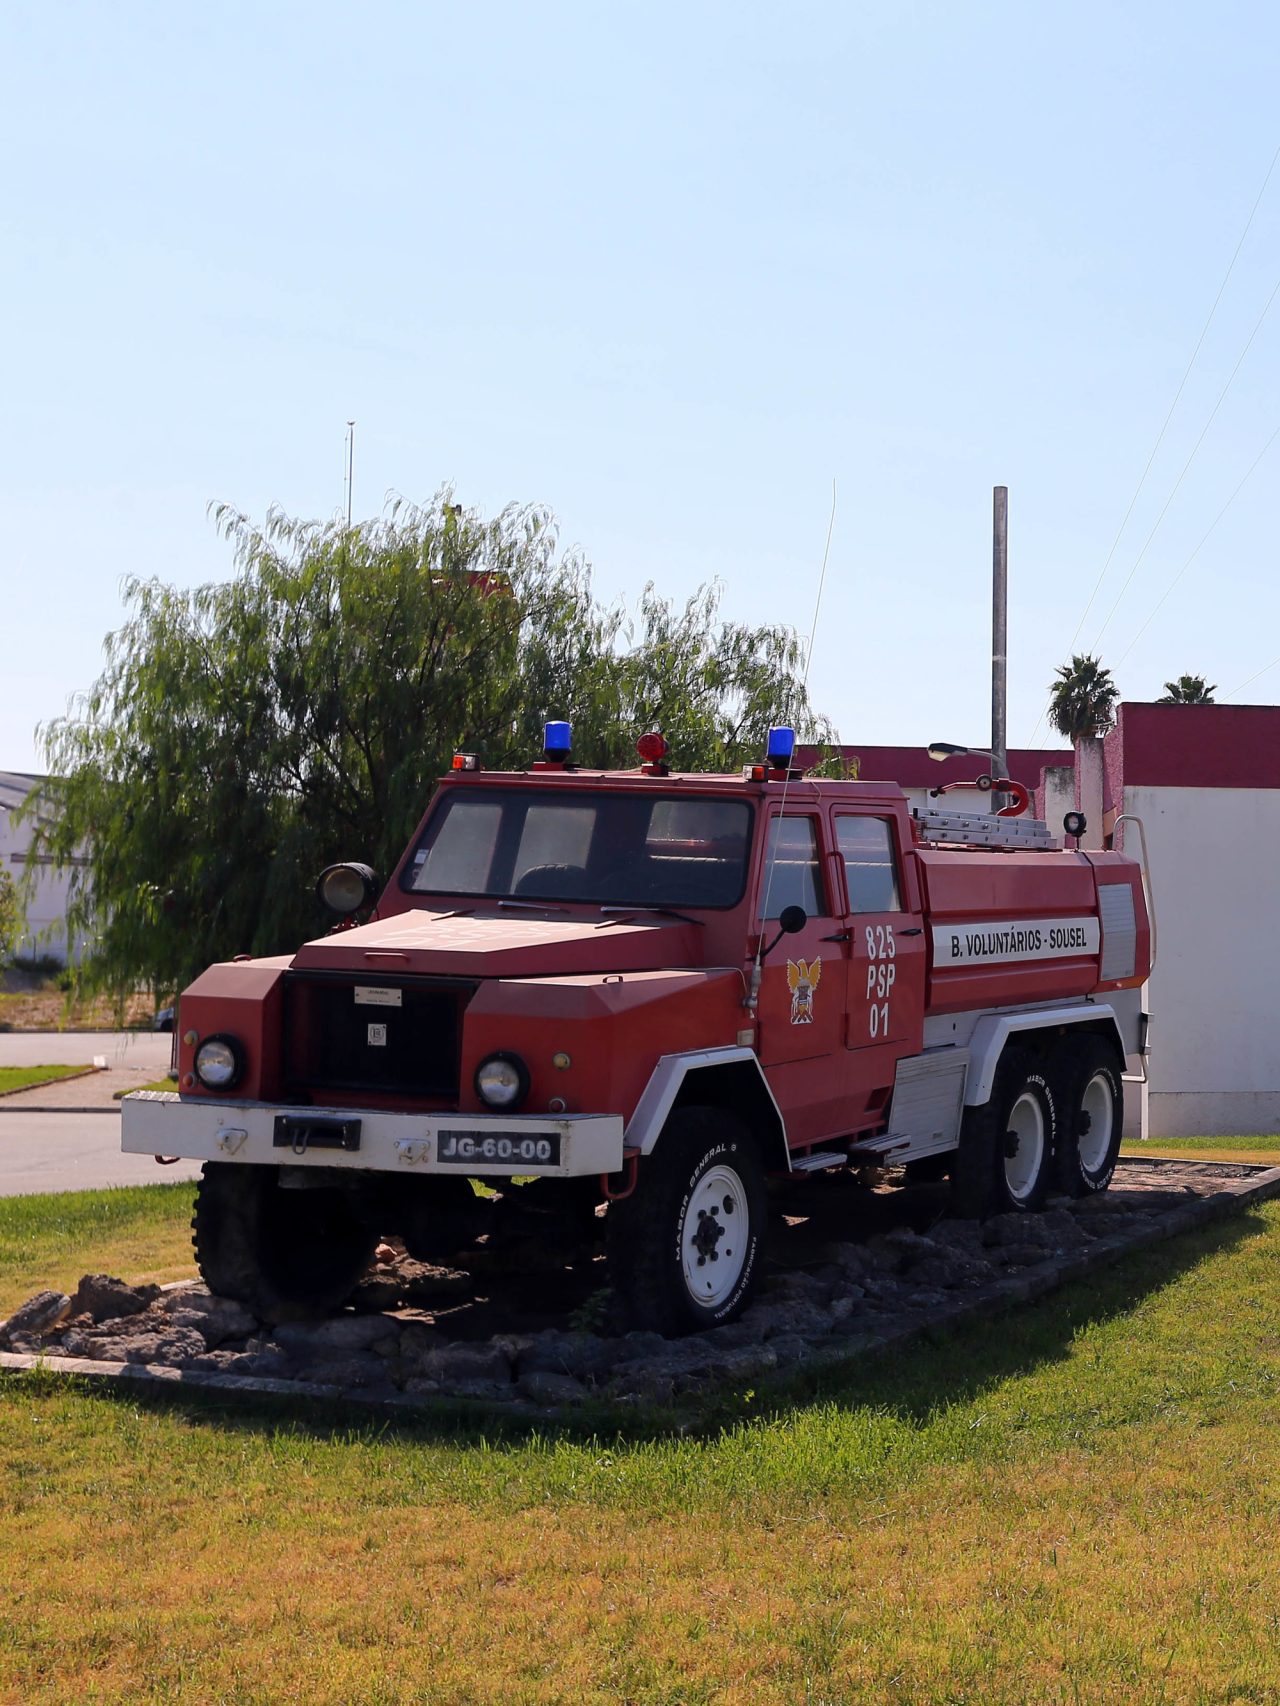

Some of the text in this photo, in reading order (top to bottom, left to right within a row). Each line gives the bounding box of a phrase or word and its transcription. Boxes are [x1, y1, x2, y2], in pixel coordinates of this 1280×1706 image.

[865, 925, 896, 960] 825
[951, 935, 963, 957] B.
[965, 926, 1042, 956] VOLUNTÁRIOS
[1049, 927, 1087, 949] SOUSEL
[866, 964, 896, 999] PSP
[869, 1002, 889, 1038] 01
[442, 1137, 551, 1159] JG-60-00
[675, 1143, 727, 1261] MABOR GENERAL
